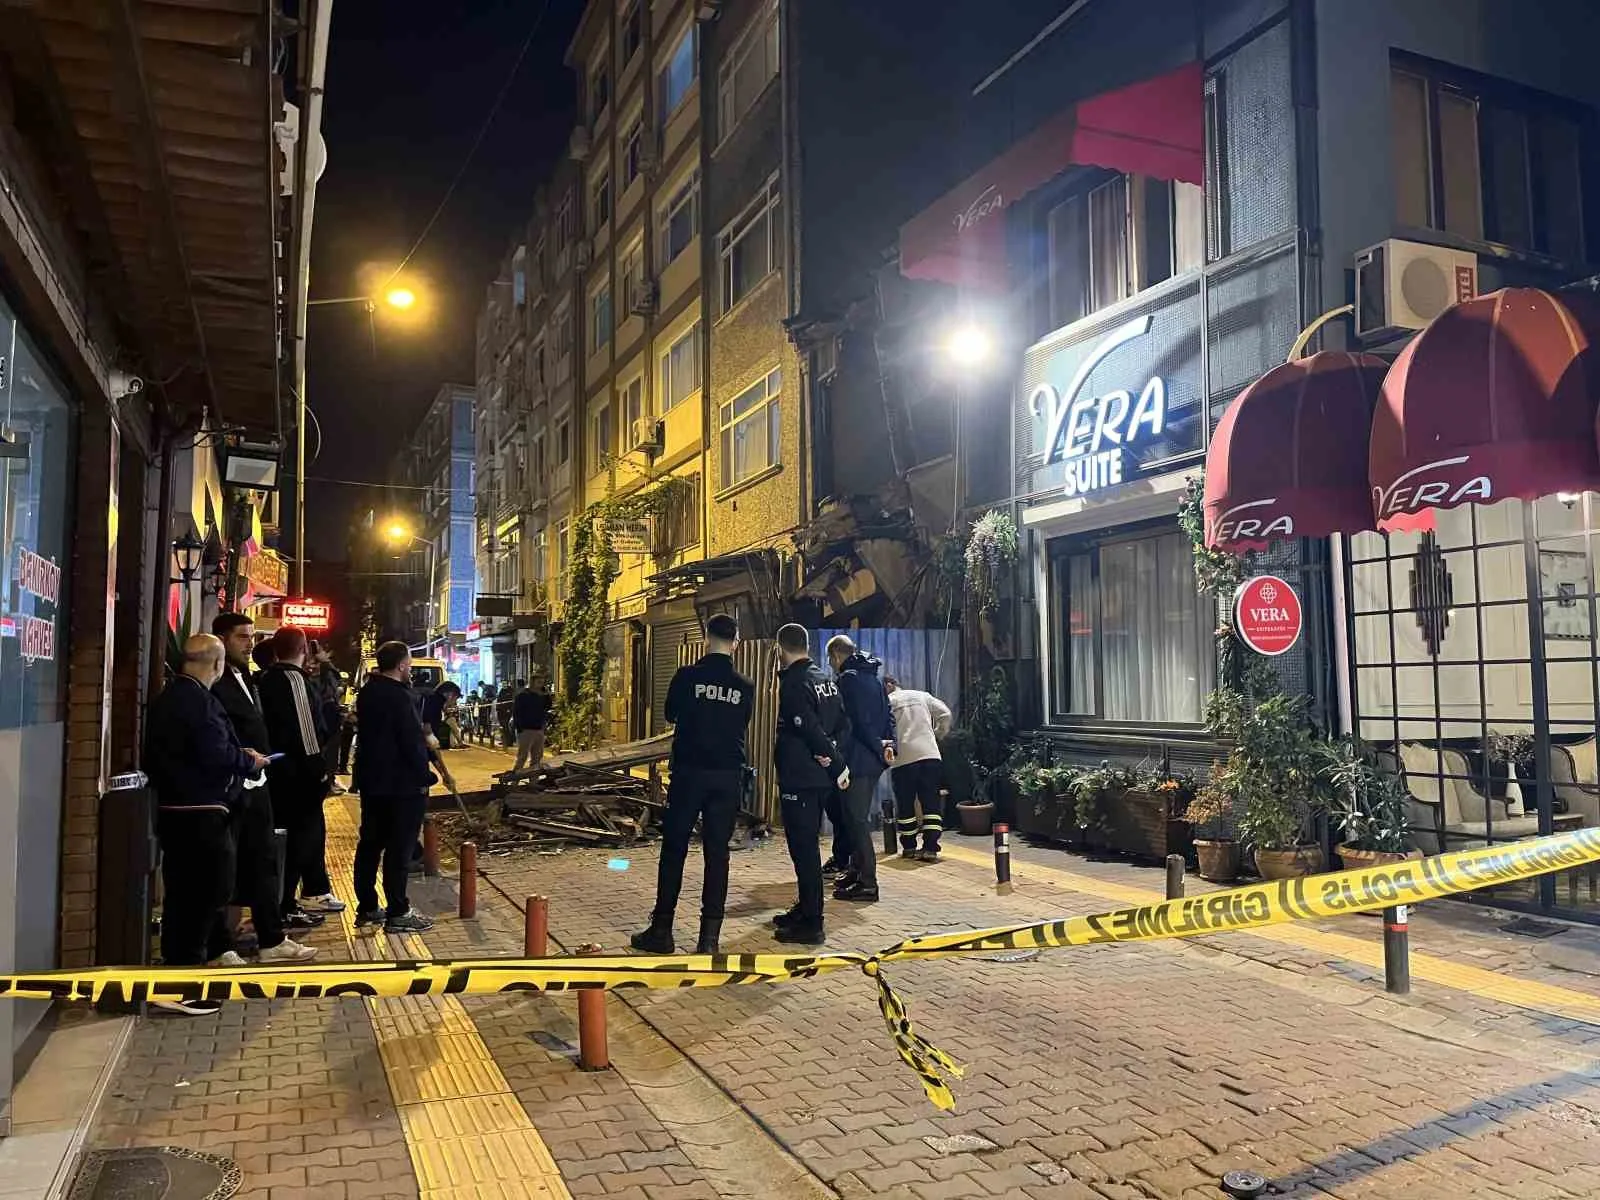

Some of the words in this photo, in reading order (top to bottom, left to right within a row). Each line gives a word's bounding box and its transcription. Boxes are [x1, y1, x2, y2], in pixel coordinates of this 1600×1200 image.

[952, 184, 1002, 232] VERA
[1460, 269, 1472, 303] STEL
[1028, 315, 1166, 465] VERA
[1063, 448, 1122, 496] SUITE
[1371, 455, 1491, 516] VERA
[1250, 607, 1290, 622] VERA
